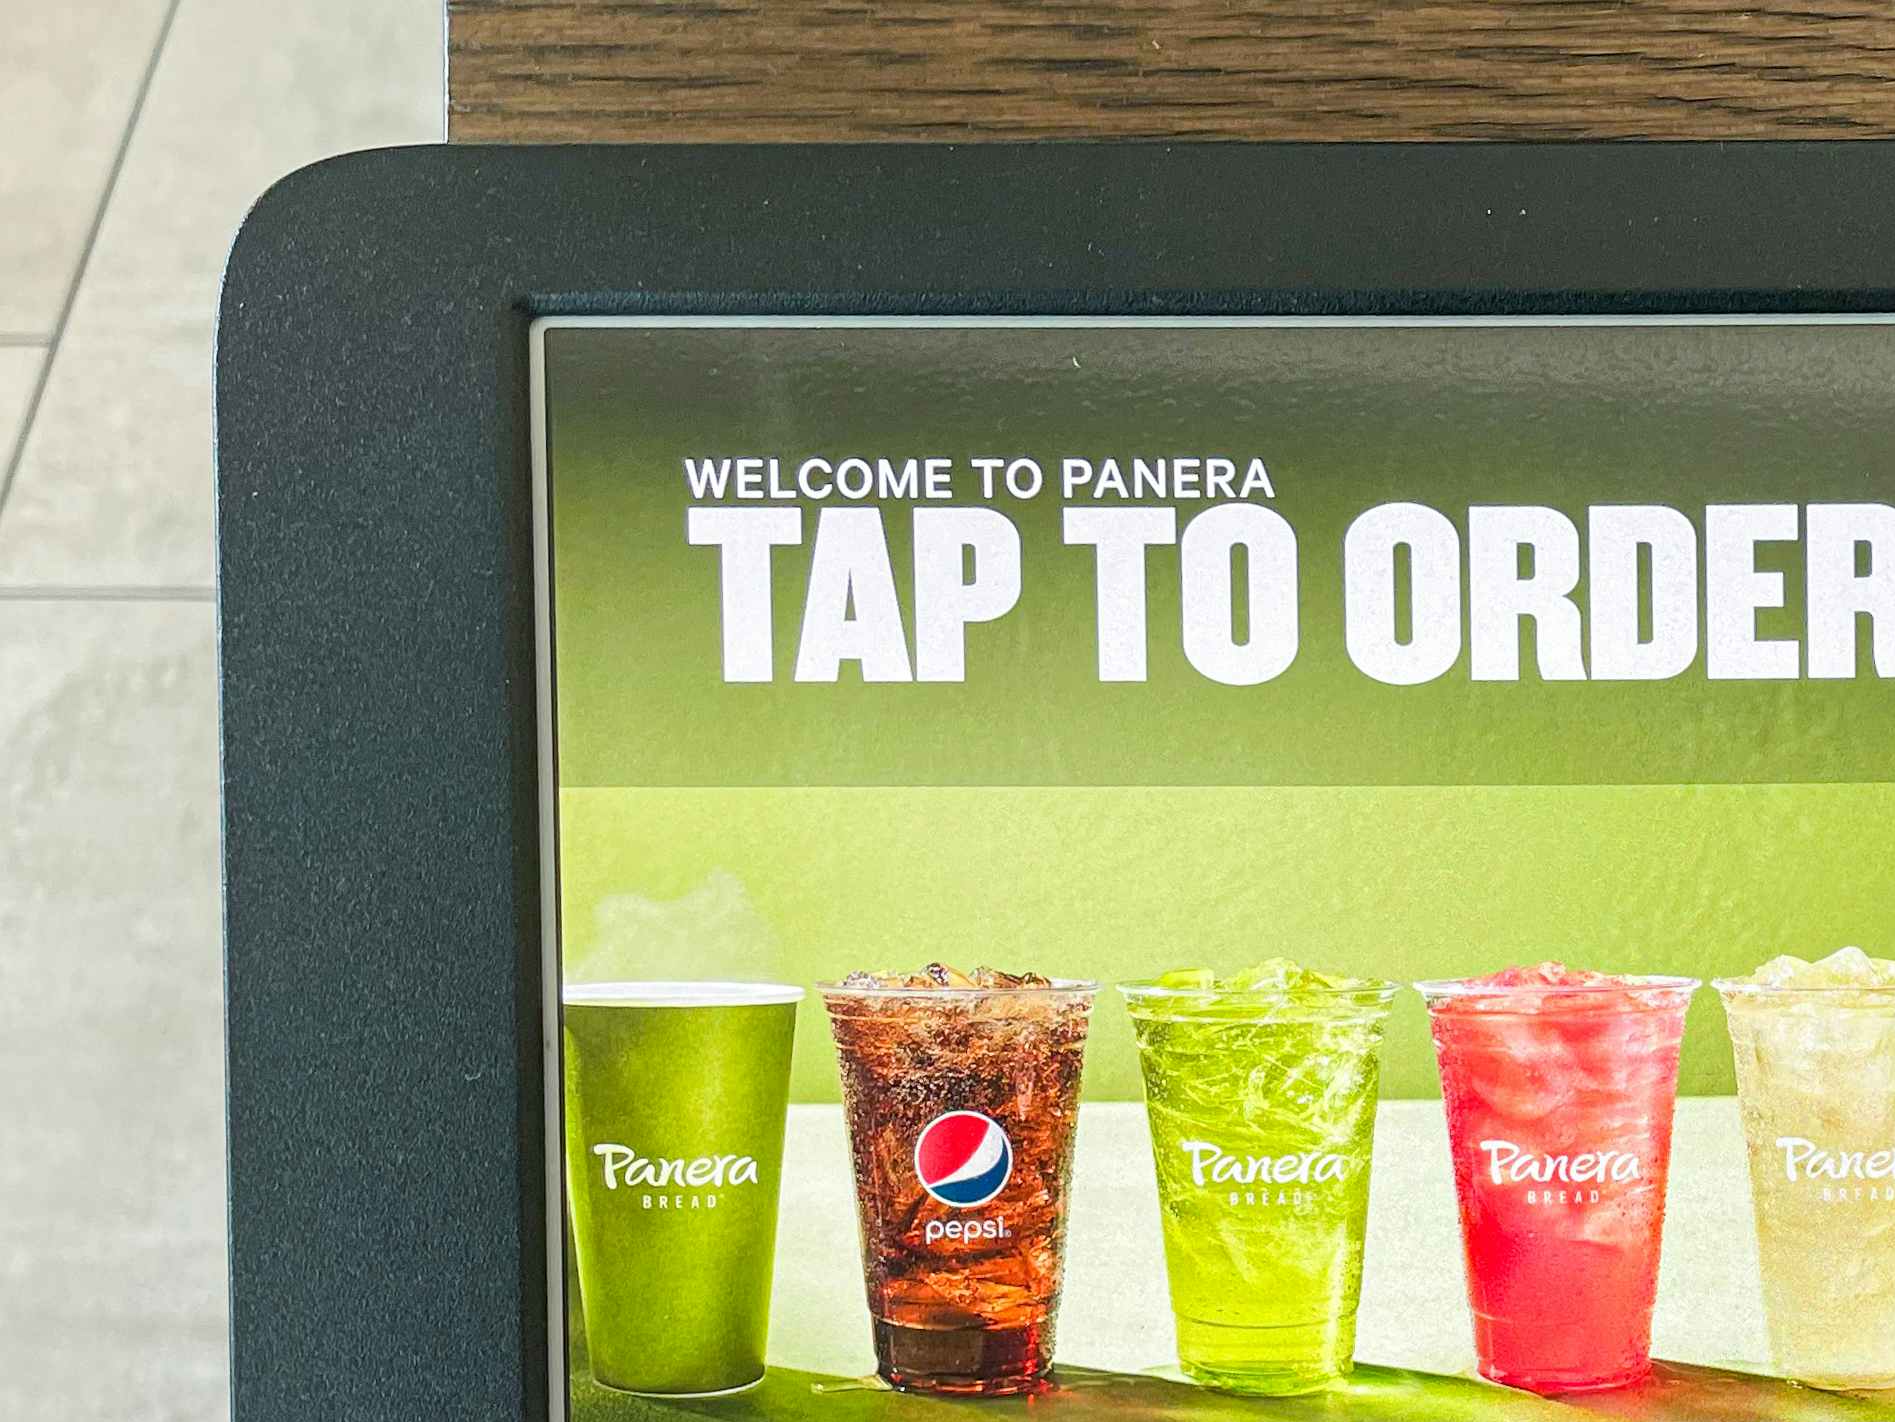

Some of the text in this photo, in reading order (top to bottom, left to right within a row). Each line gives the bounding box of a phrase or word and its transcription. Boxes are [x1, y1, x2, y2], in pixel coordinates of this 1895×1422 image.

[684, 457, 1275, 499] WELCOME TO PANERA
[687, 506, 1023, 683] TAP
[1062, 502, 1299, 686] TO
[592, 1142, 758, 1190] Panera
[1181, 1140, 1345, 1186] Panera
[1480, 1139, 1640, 1185] Panera
[641, 1195, 717, 1209] BREAD
[1527, 1190, 1599, 1204] BREAD
[925, 1215, 1005, 1245] pepsi
